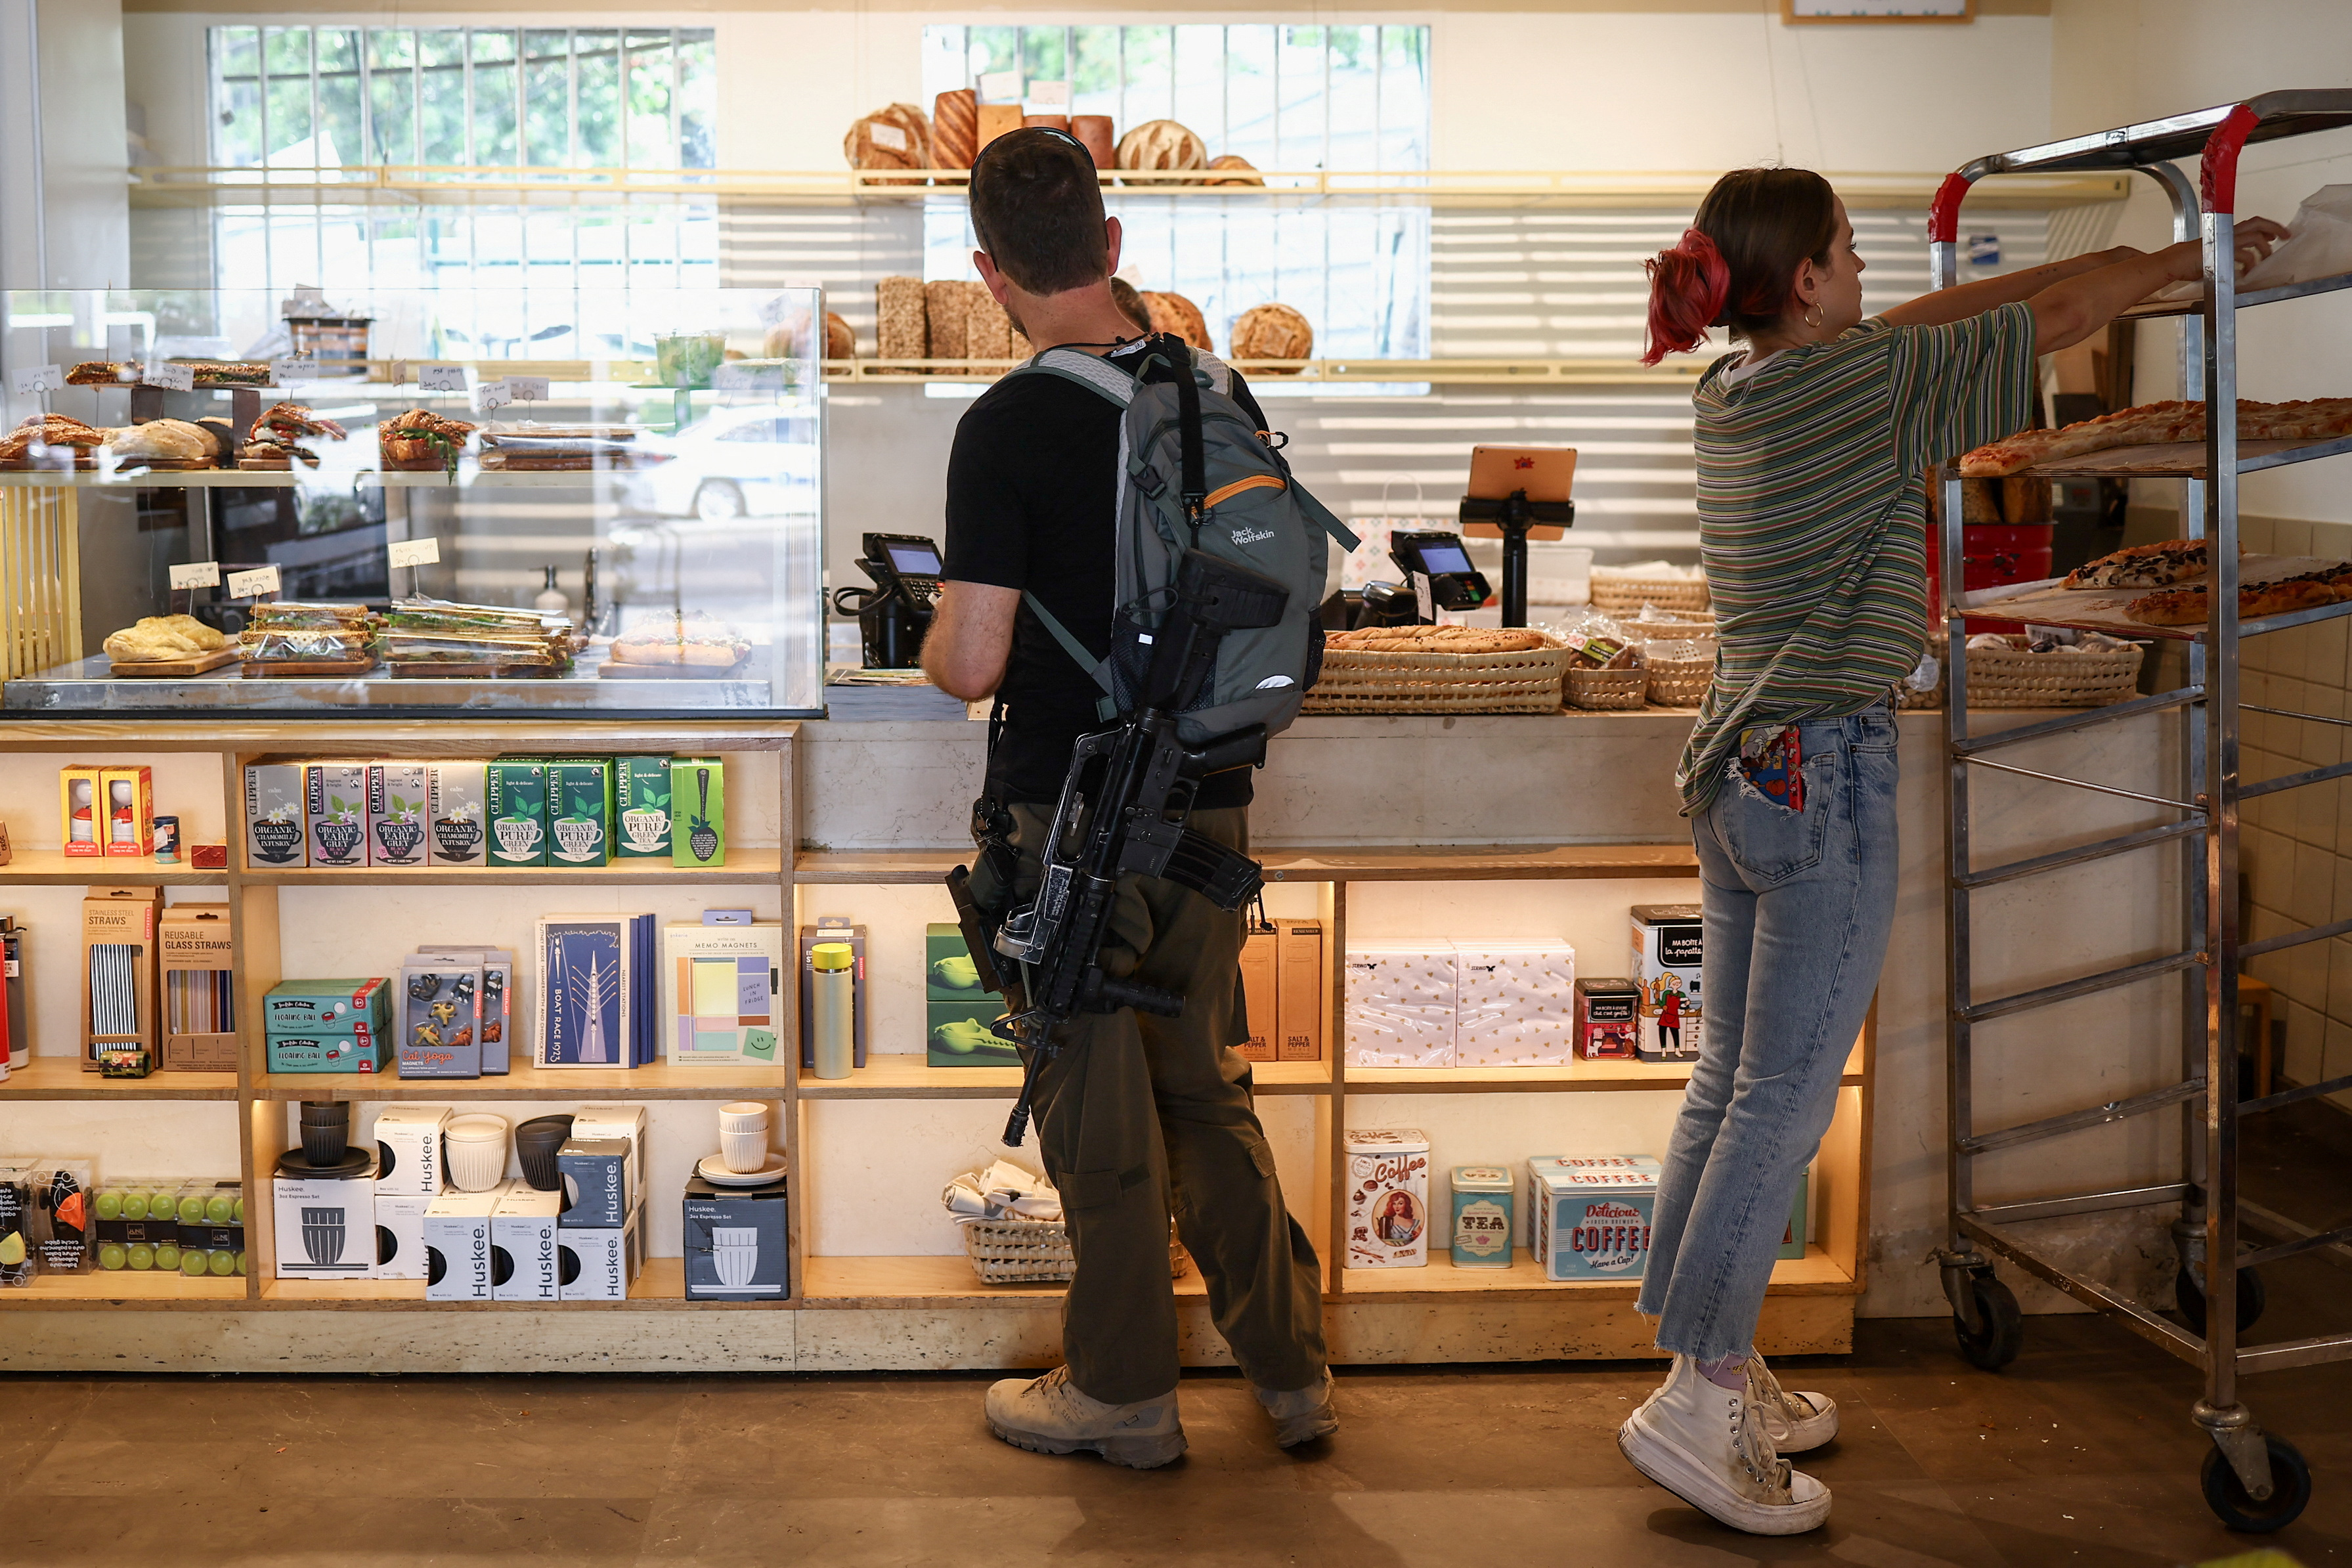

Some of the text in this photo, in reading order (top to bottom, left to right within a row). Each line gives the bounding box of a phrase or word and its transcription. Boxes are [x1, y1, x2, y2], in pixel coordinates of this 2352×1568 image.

[1231, 527, 1253, 538] Jack
[1232, 530, 1274, 545] Wolfskin
[490, 770, 499, 814] CLIPPER
[619, 762, 627, 806] CLIPPER
[628, 823, 661, 831] PURE
[559, 832, 593, 840] PURE
[165, 941, 195, 949] GLASS
[743, 983, 760, 991] LUNCH
[745, 996, 764, 1005] FRIDGE
[402, 1051, 453, 1065] Cat Yoga
[550, 1042, 561, 1062] 1923
[421, 1133, 432, 1192] Huskee.
[1375, 1154, 1426, 1183] Coffee
[1555, 1158, 1639, 1167] COFFEE
[1569, 1175, 1653, 1183] COFFEE
[605, 1161, 618, 1223] Huskee.
[1586, 1202, 1640, 1218] Delicious
[1462, 1217, 1504, 1230] TEA
[1572, 1226, 1651, 1252] COFFEE
[471, 1225, 486, 1297] Huskee.
[537, 1225, 553, 1297] Huskee.
[605, 1236, 619, 1296] Huskee.
[1590, 1260, 1610, 1269] Have
[1617, 1253, 1634, 1265] Cup!
